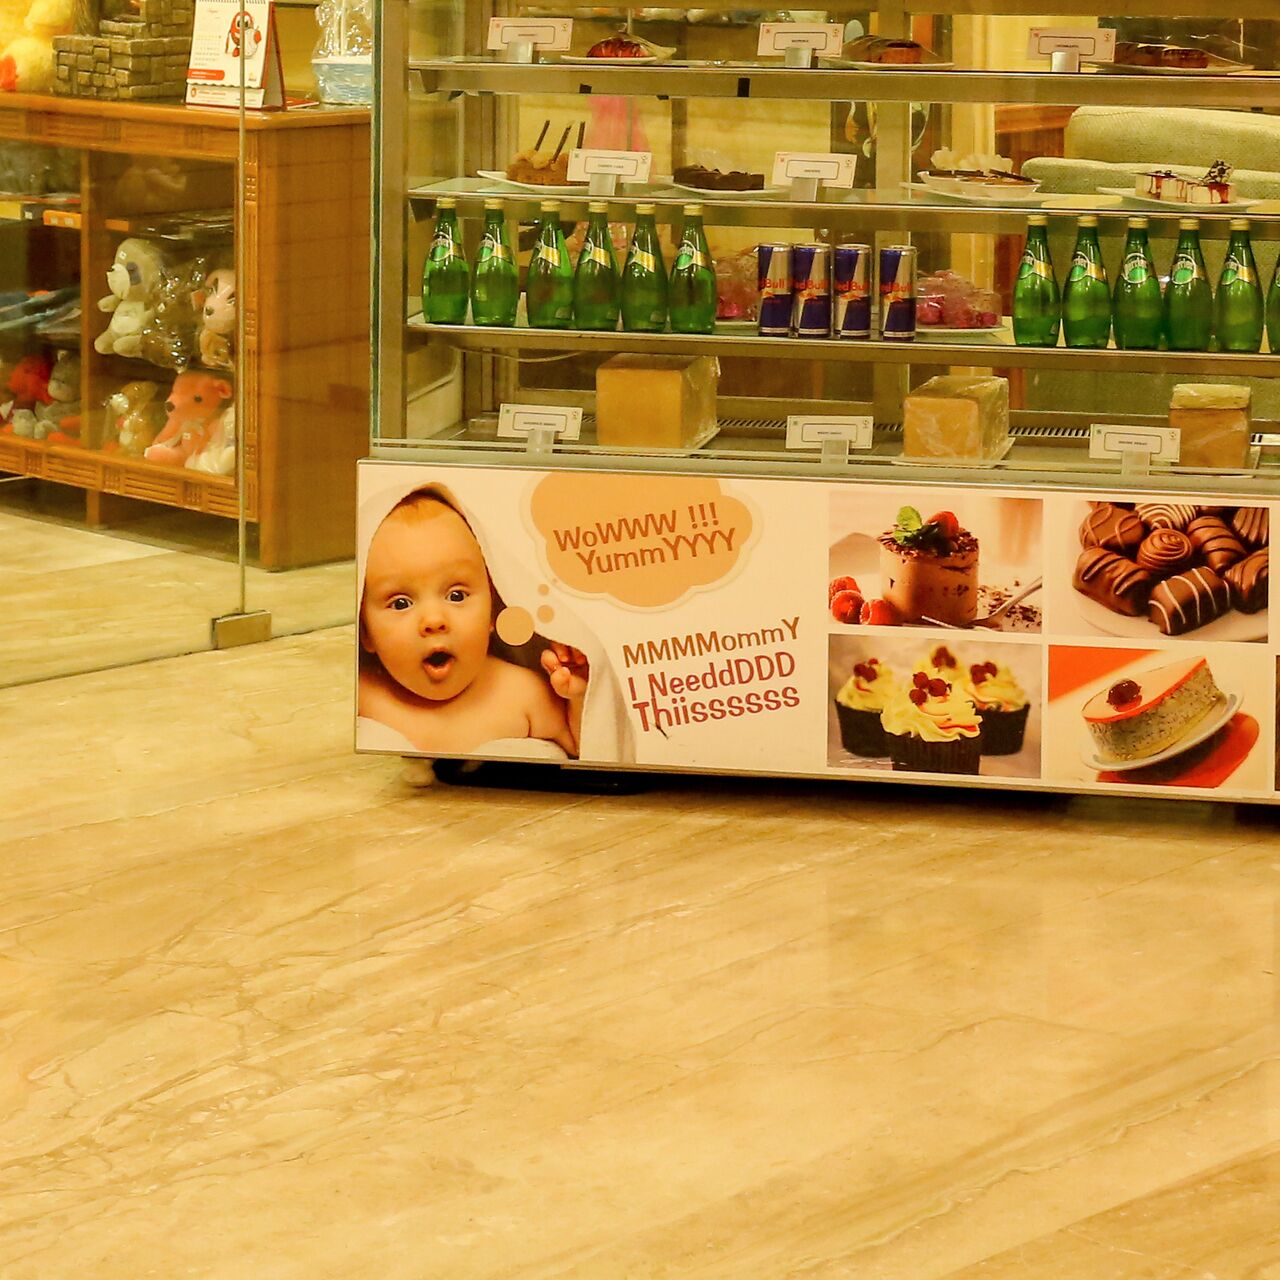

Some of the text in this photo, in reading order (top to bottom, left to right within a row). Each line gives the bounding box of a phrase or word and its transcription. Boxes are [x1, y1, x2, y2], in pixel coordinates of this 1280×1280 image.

[553, 502, 719, 551] WoWWW !!!
[576, 527, 736, 575] YummYYYY
[622, 616, 800, 669] MMMMommY
[628, 651, 795, 702] I NeeddDDD
